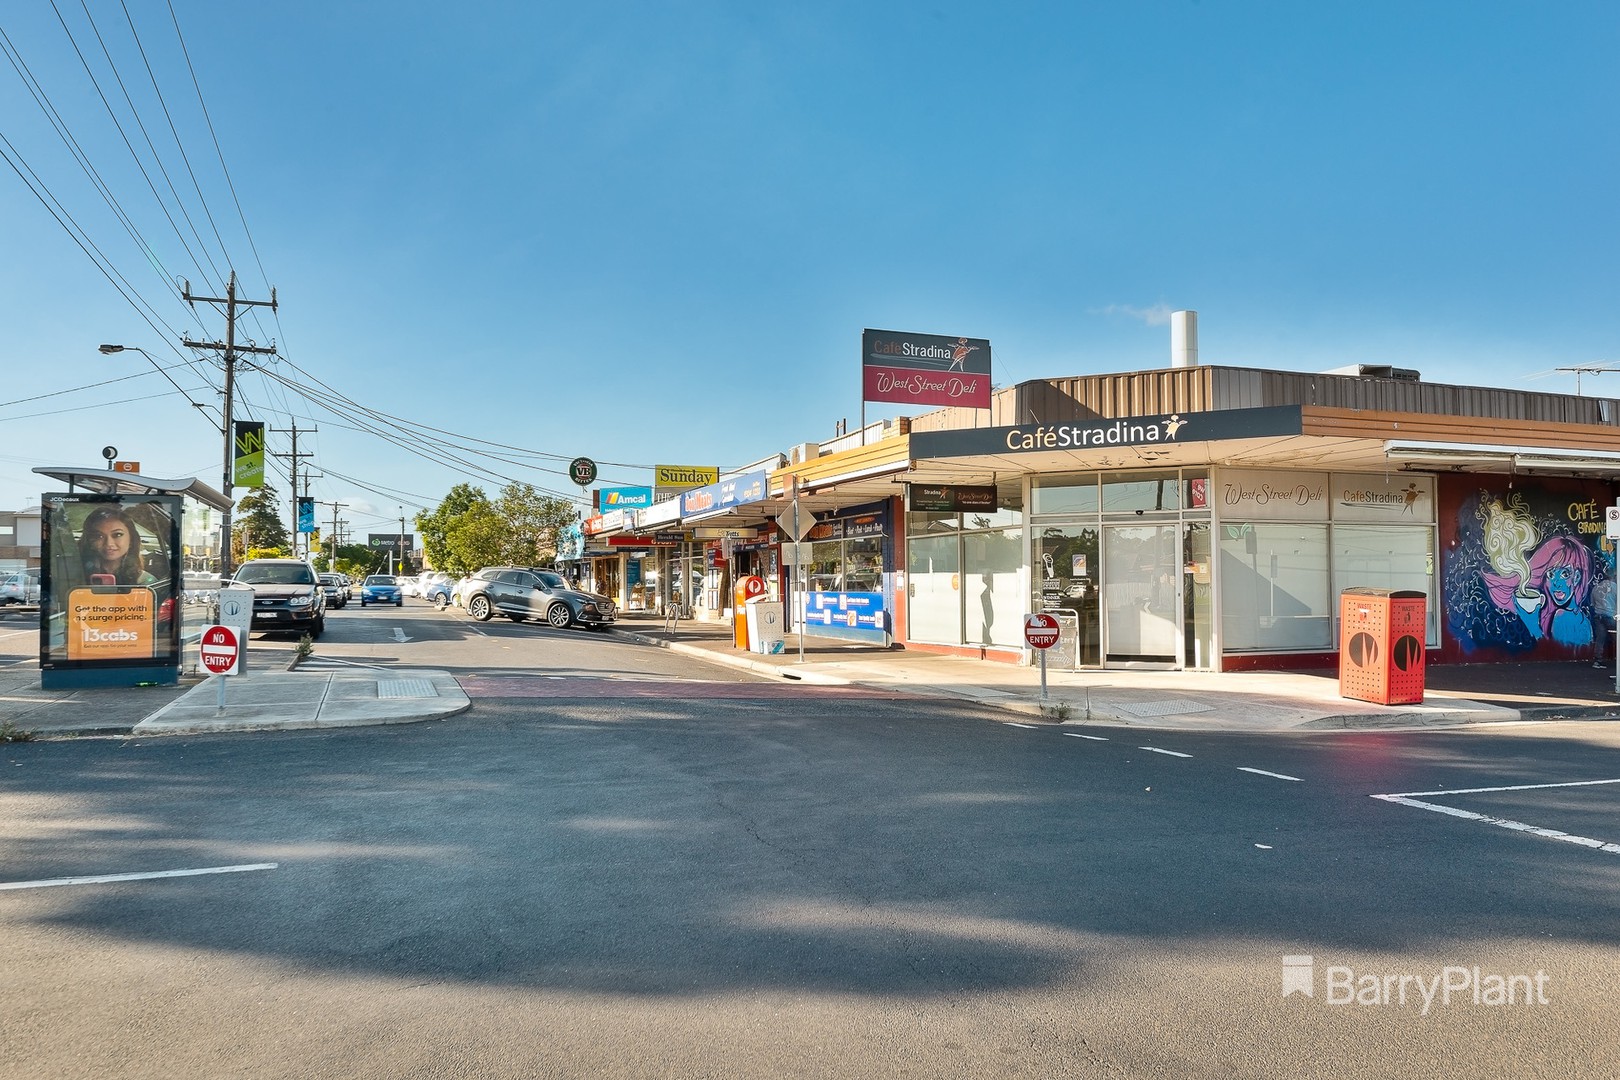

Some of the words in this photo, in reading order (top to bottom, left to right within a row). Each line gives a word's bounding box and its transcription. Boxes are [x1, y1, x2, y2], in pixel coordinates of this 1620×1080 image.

[877, 372, 908, 393] West
[908, 375, 948, 395] Street
[948, 378, 977, 398] Deli
[1006, 421, 1159, 450] CaféStradina
[577, 467, 591, 476] VB
[660, 469, 712, 486] Sunday
[617, 494, 646, 504] Amcal
[1225, 482, 1256, 505] West
[1256, 483, 1294, 505] Street
[1295, 484, 1323, 506] Deli
[1568, 498, 1600, 521] CAFÉ
[114, 614, 147, 622] pricing.
[83, 628, 138, 642] 13cabs
[212, 633, 225, 644] NO
[1029, 635, 1055, 645] ENTRY
[205, 655, 232, 666] ENTRY
